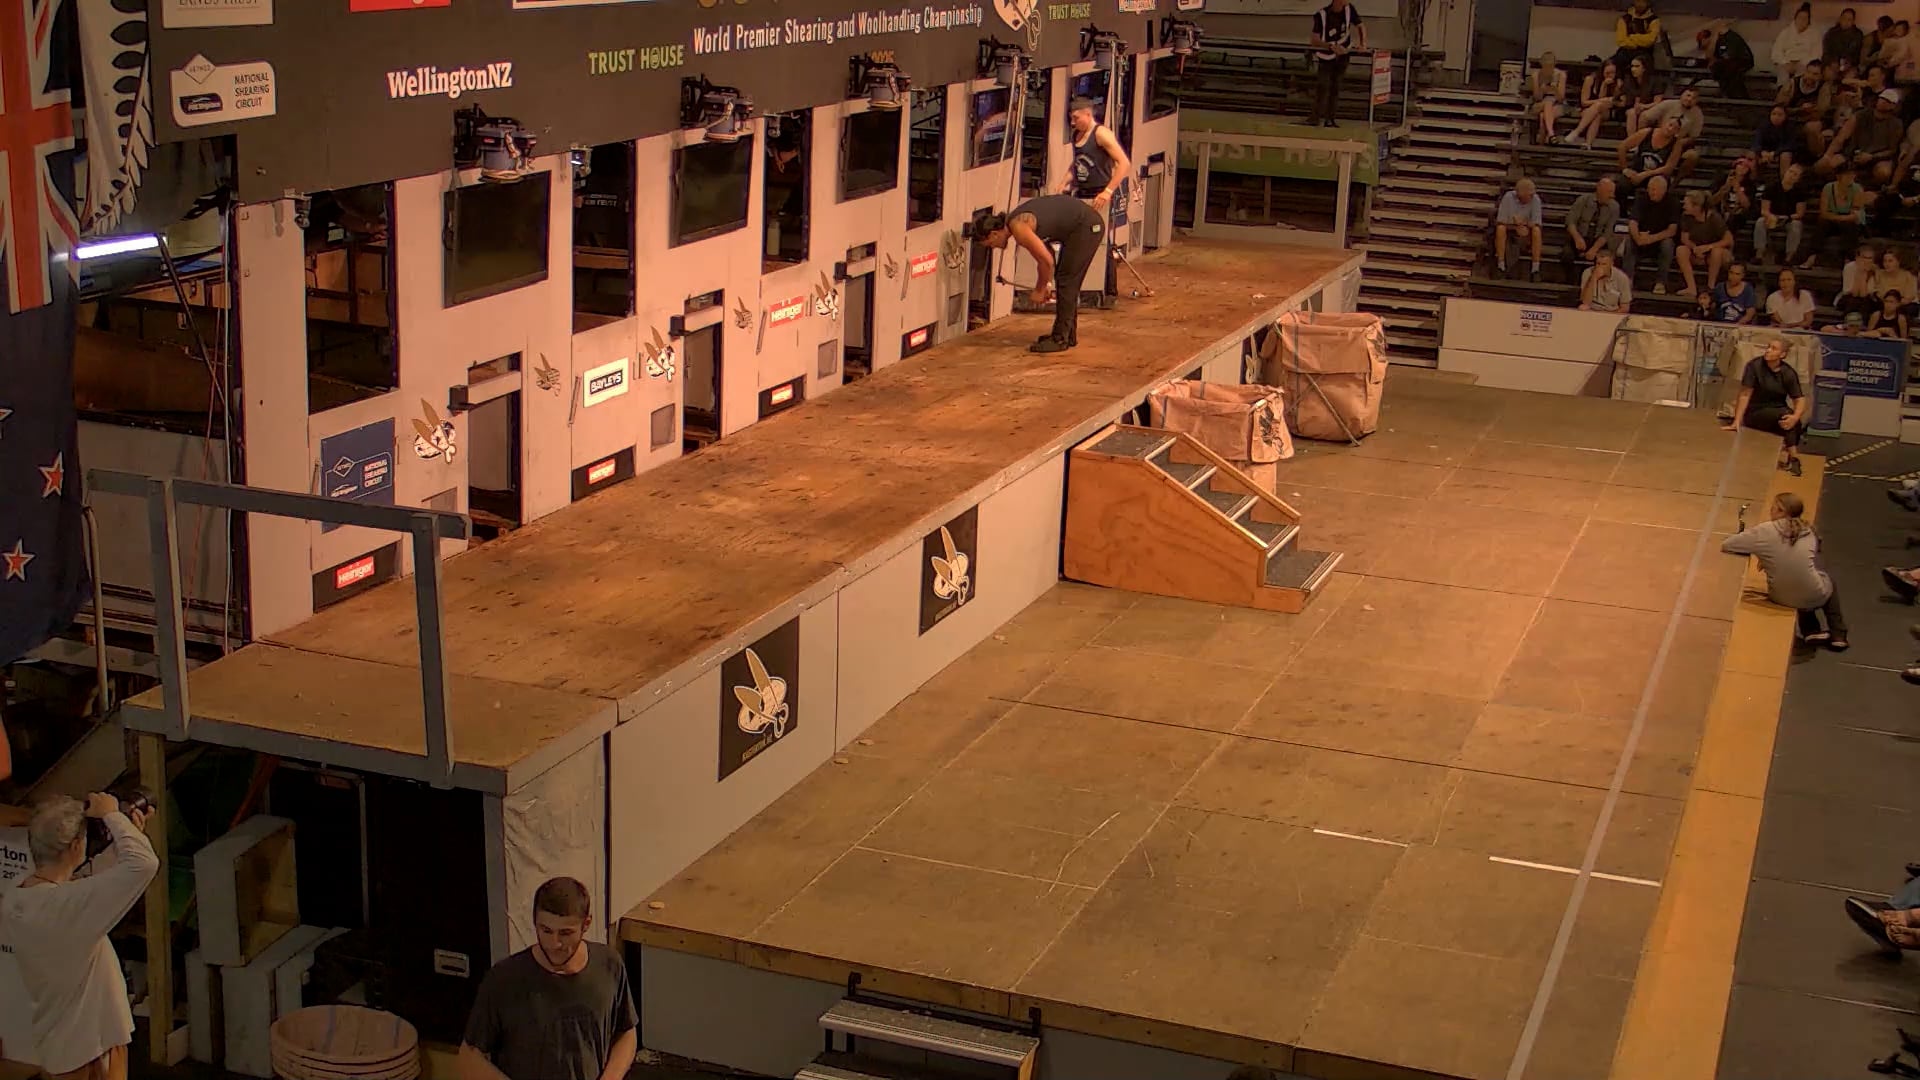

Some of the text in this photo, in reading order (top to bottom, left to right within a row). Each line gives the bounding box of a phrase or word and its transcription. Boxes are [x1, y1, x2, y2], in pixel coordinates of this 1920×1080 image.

[1049, 3, 1090, 20] TRUST HOUSE
[693, 3, 982, 54] World Premier Shearing and Woolhandling Championship
[588, 45, 684, 75] TRUST HOUSE
[234, 72, 269, 85] NATIONAL
[386, 62, 512, 99] WellingtonNZ
[234, 84, 270, 97] SHEARING
[235, 97, 262, 109] CIRCUIT
[1849, 360, 1891, 370] NATIONAL
[591, 372, 622, 392] BAYLEYS
